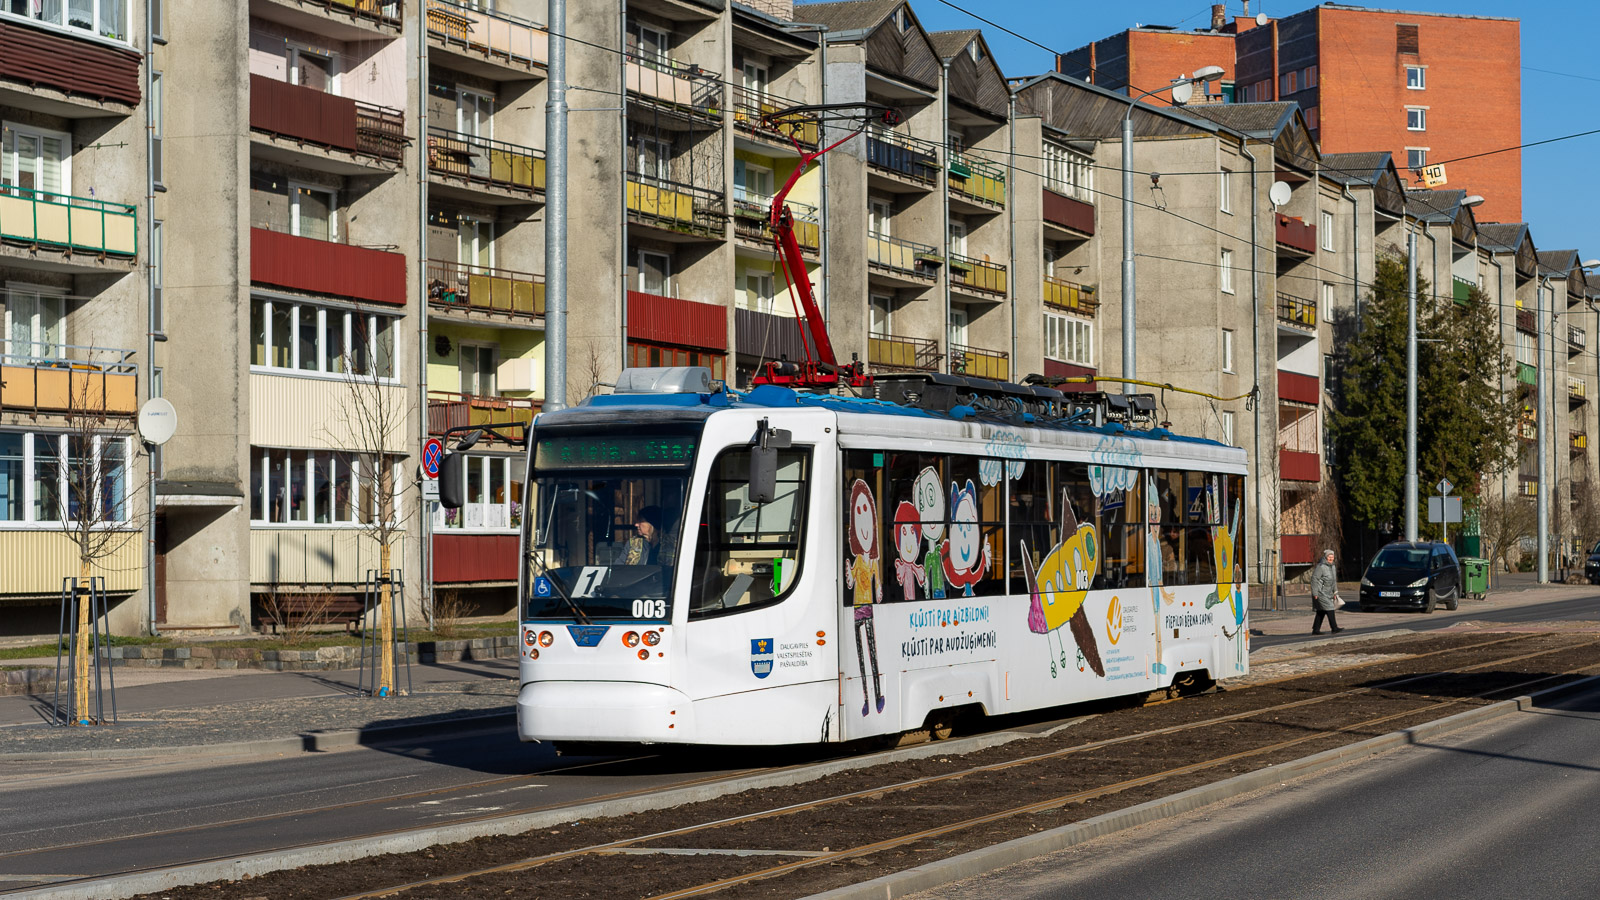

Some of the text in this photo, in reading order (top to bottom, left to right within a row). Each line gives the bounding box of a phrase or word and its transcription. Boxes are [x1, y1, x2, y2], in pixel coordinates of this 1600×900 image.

[1426, 167, 1441, 178] 40
[583, 569, 599, 595] 1
[632, 599, 666, 619] 003
[937, 609, 951, 627] PAR
[780, 642, 809, 650] DAUGAVPILS
[929, 637, 944, 655] PAR
[776, 651, 813, 659] VALSTSPILSĒTAS
[779, 660, 808, 668] PAŠVALDĪBA
